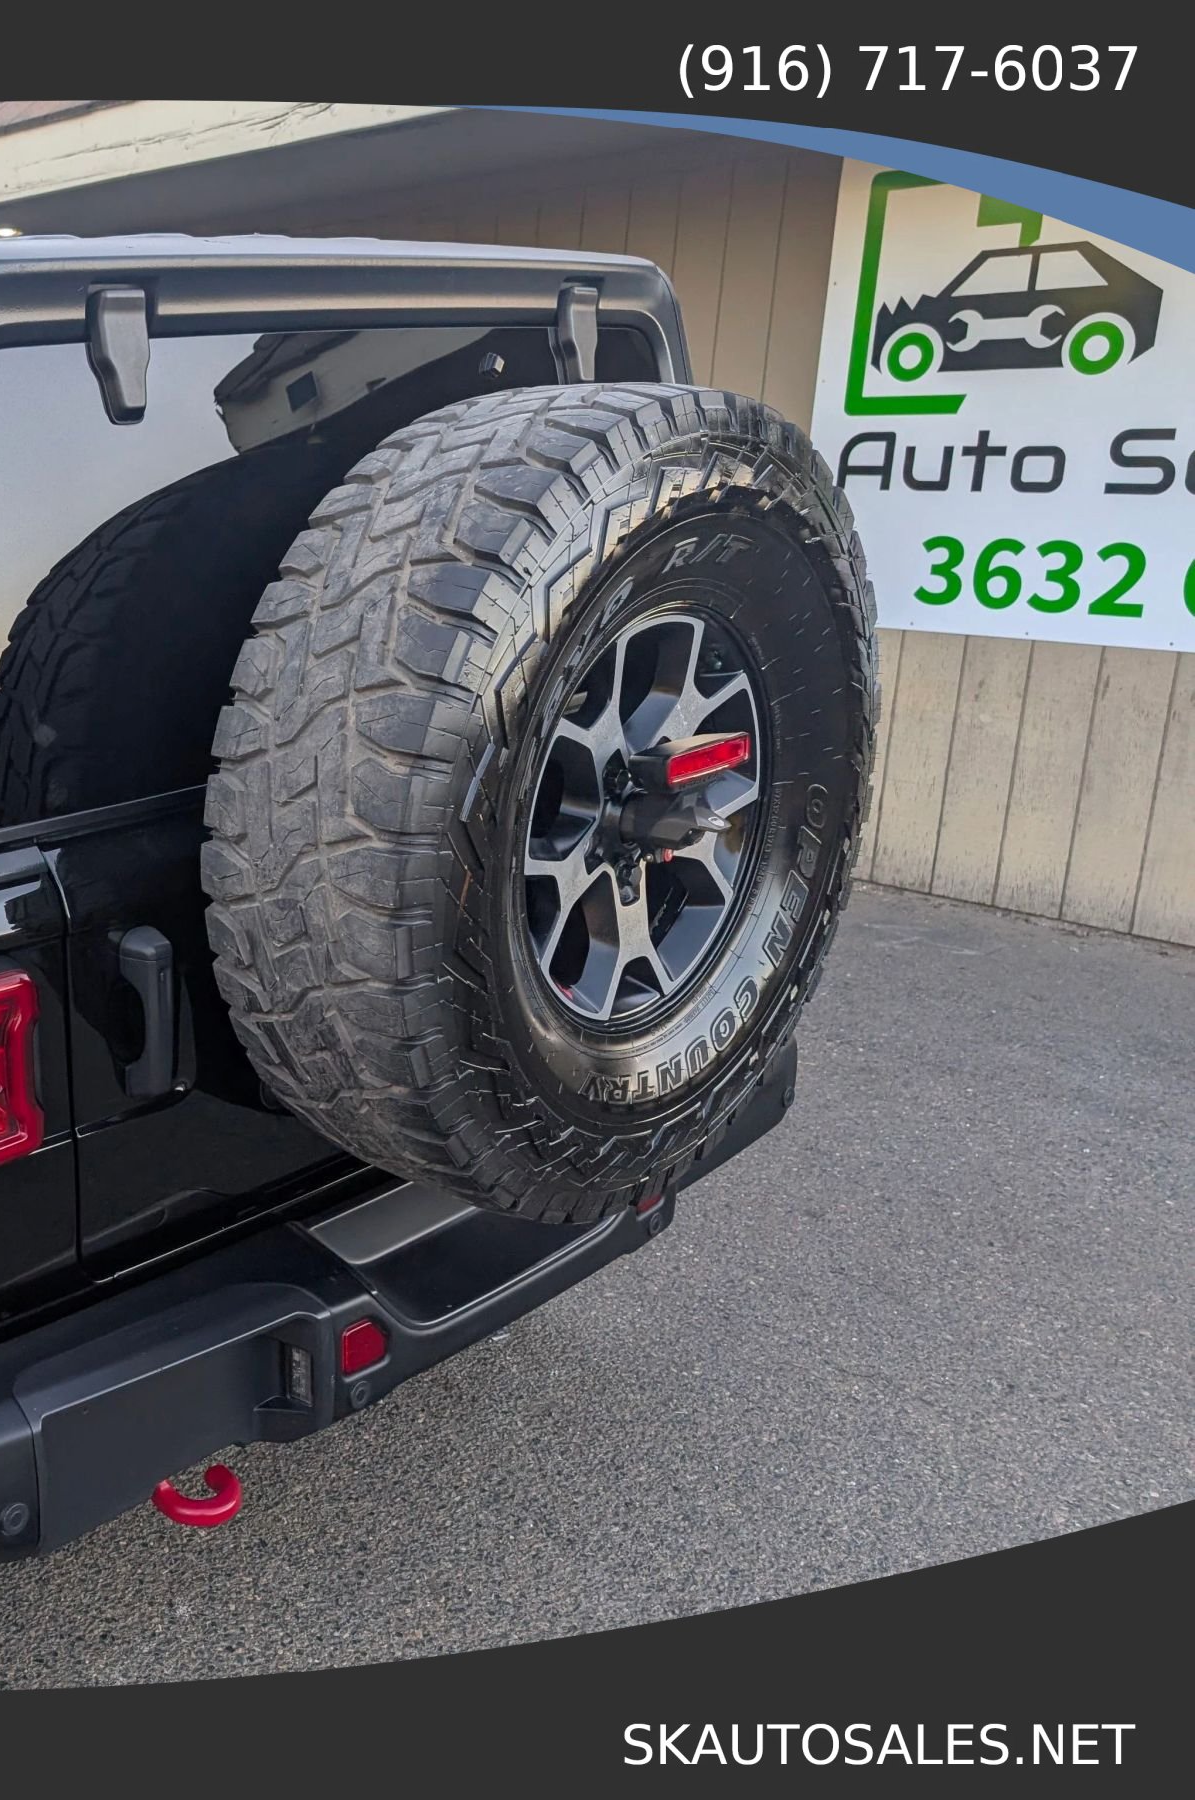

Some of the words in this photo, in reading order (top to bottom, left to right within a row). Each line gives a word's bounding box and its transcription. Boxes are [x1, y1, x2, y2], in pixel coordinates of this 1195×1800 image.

[836, 430, 1066, 493] Auto
[913, 535, 1147, 618] 3632
[762, 783, 830, 970] OPEN
[576, 974, 760, 1105] COUNTRY
